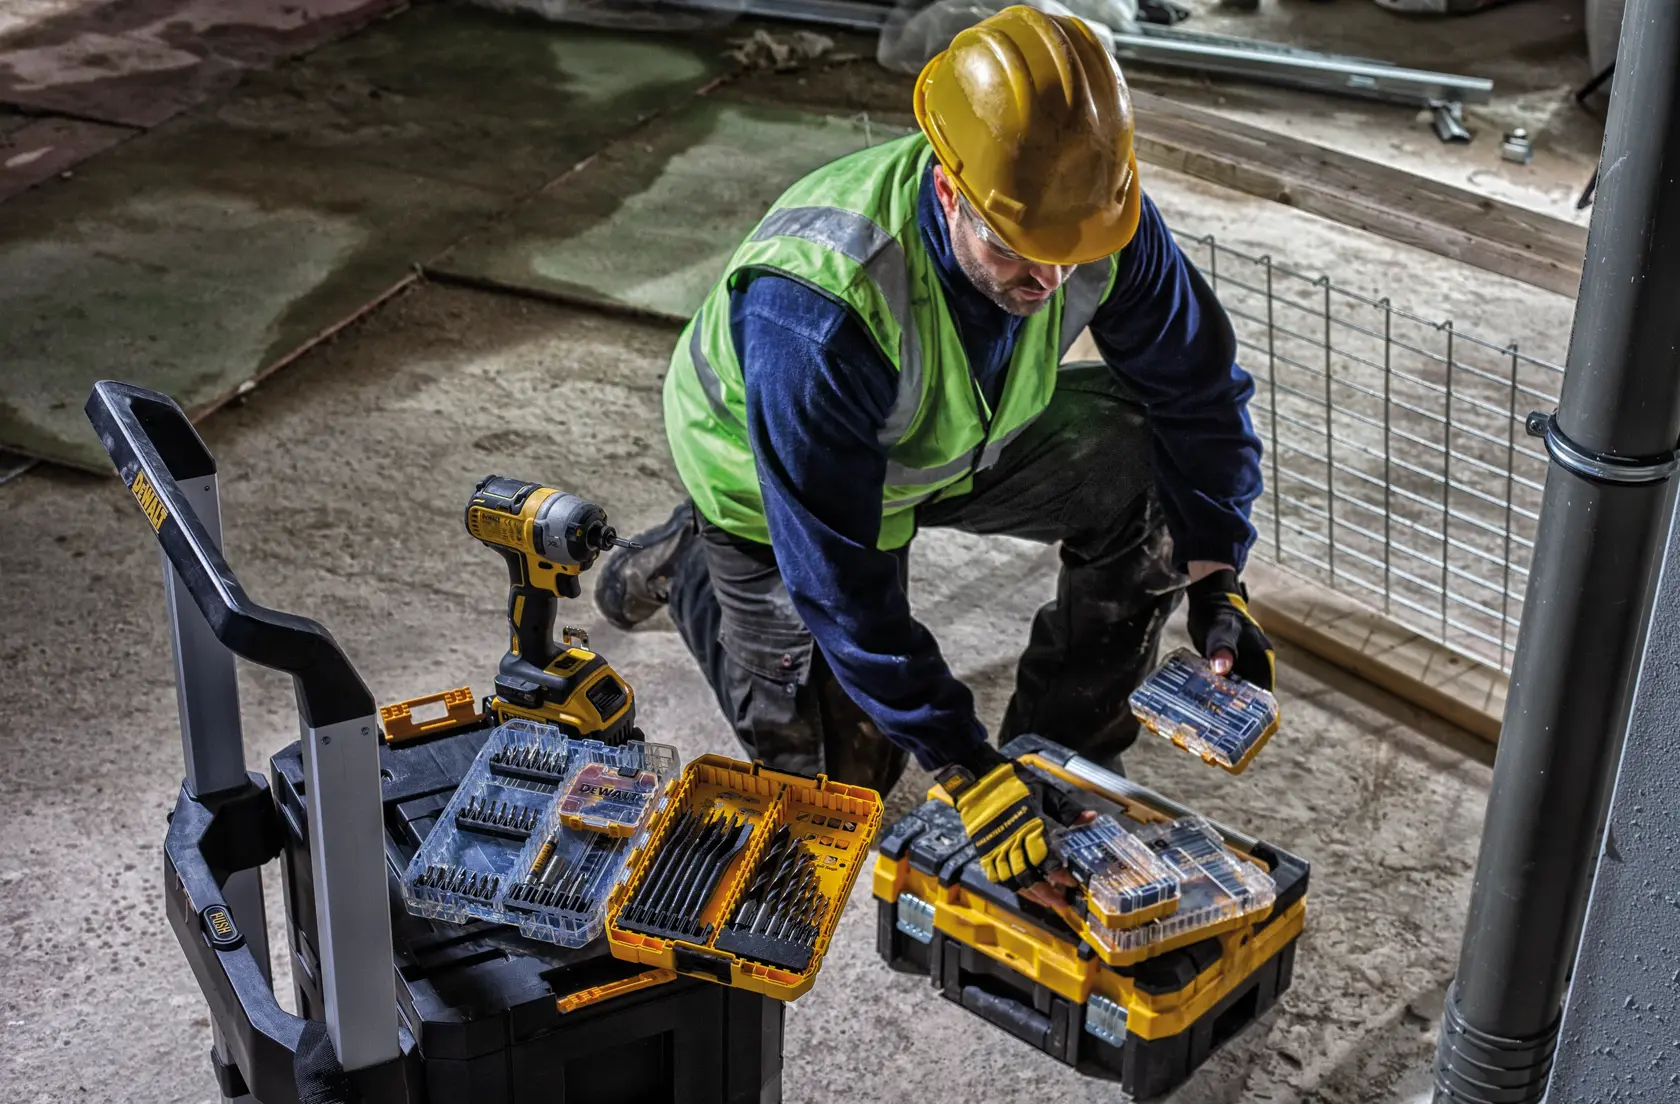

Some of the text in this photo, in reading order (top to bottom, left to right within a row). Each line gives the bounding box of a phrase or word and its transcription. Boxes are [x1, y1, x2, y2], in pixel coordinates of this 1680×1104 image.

[132, 470, 168, 530] DEWALT
[579, 783, 642, 802] DEWALT
[209, 911, 232, 936] PUSH
